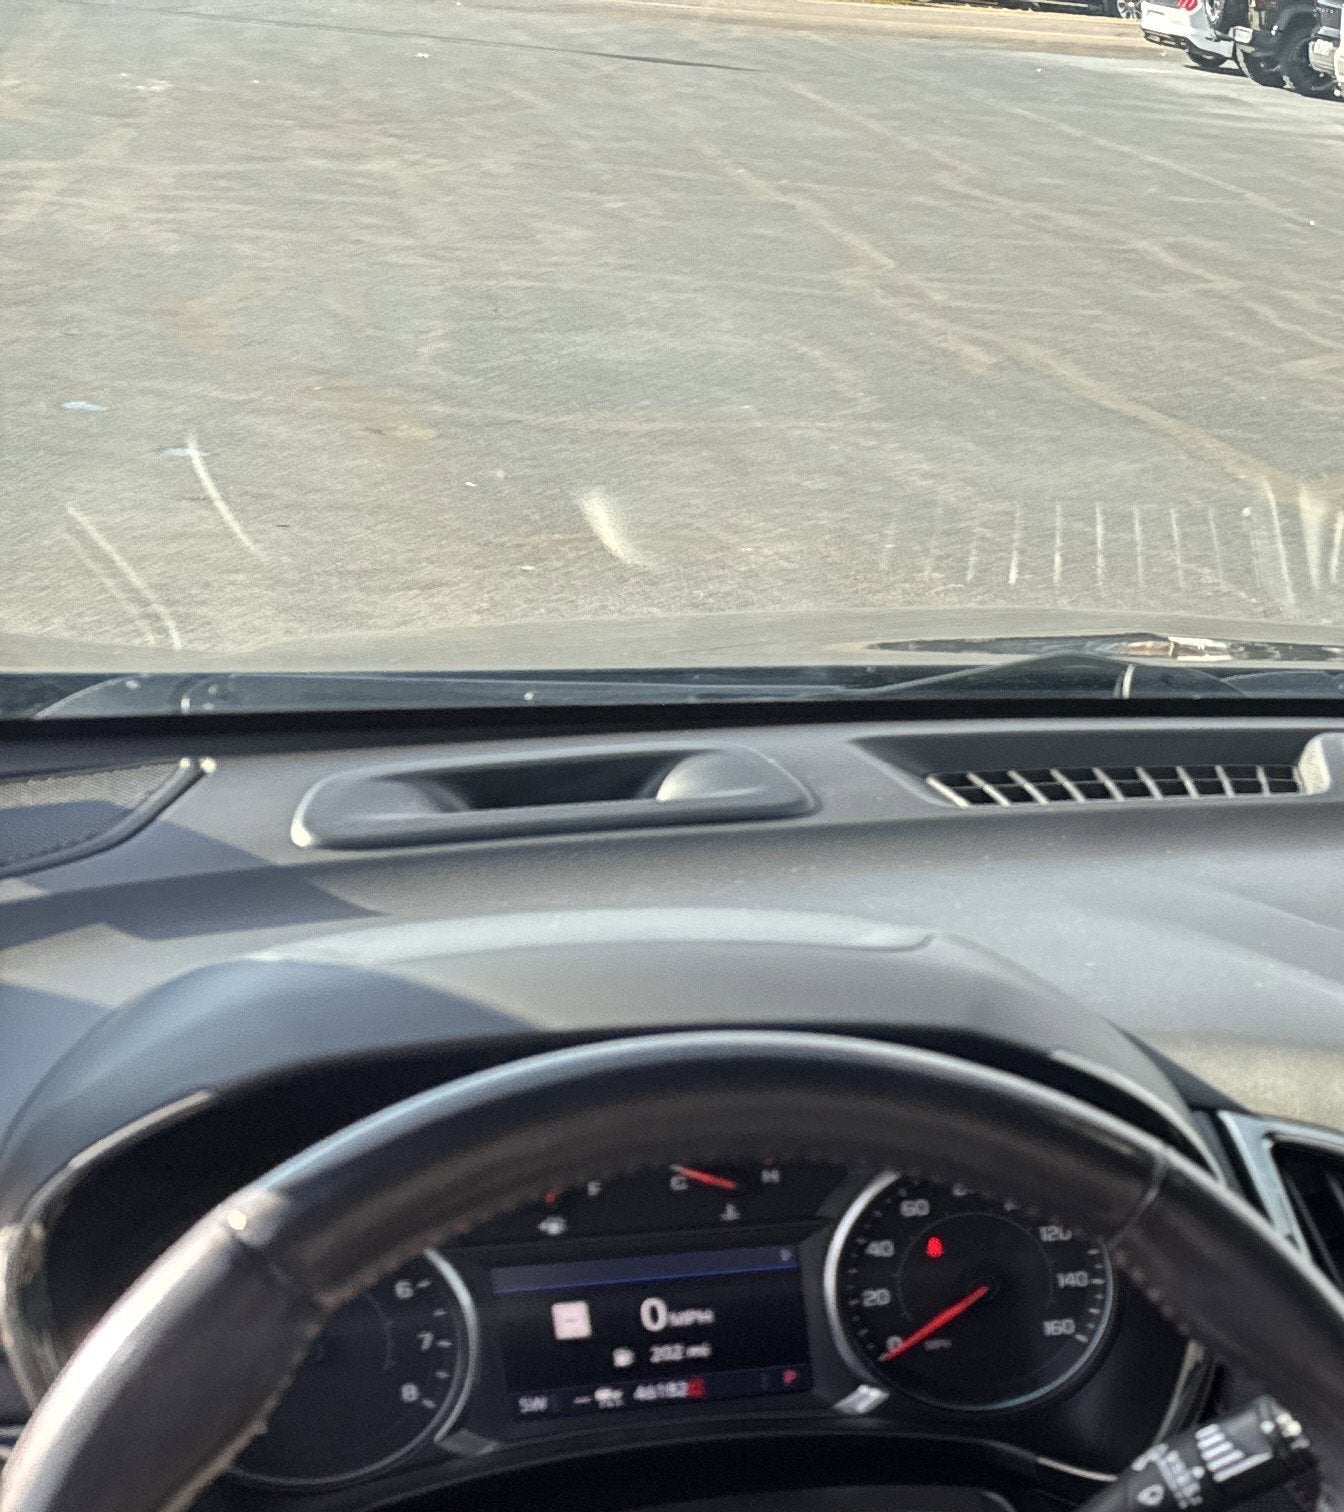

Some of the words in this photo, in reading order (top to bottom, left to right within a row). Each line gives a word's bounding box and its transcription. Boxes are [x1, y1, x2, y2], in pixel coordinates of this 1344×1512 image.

[900, 1199, 930, 1218] 60
[865, 1240, 895, 1258] 40
[1056, 1270, 1089, 1289] 140
[395, 1280, 414, 1299] 6
[861, 1288, 891, 1308] 20
[640, 1297, 668, 1333] 0
[1043, 1318, 1076, 1337] 160
[417, 1331, 434, 1351] 7
[401, 1383, 419, 1403] 8
